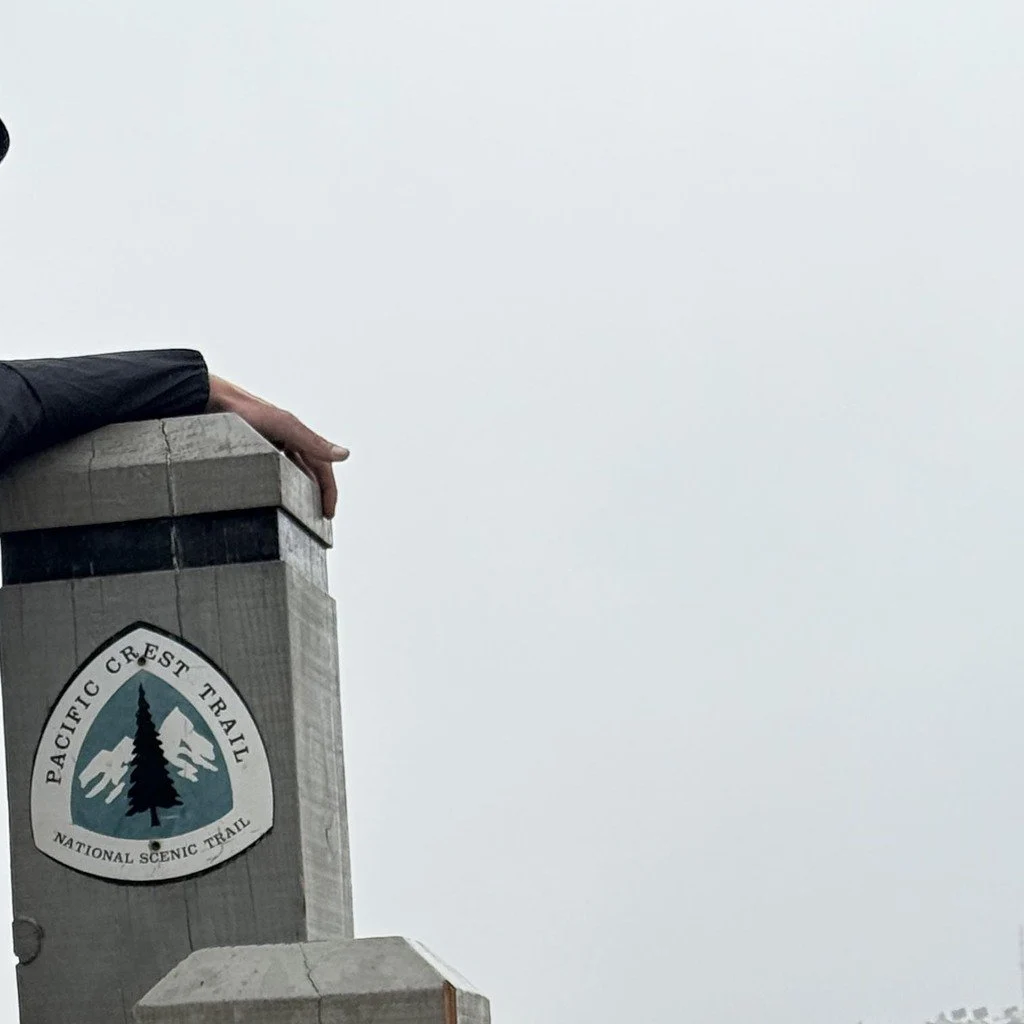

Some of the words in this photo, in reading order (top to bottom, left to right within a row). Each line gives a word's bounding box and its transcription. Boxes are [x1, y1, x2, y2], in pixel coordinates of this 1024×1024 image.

[45, 680, 100, 785] PACIFIC
[105, 642, 189, 678] CREST
[198, 683, 250, 763] TRAIL
[54, 831, 134, 864] NATIONAL
[139, 844, 198, 864] SCENIC
[204, 817, 251, 850] TRAIL
